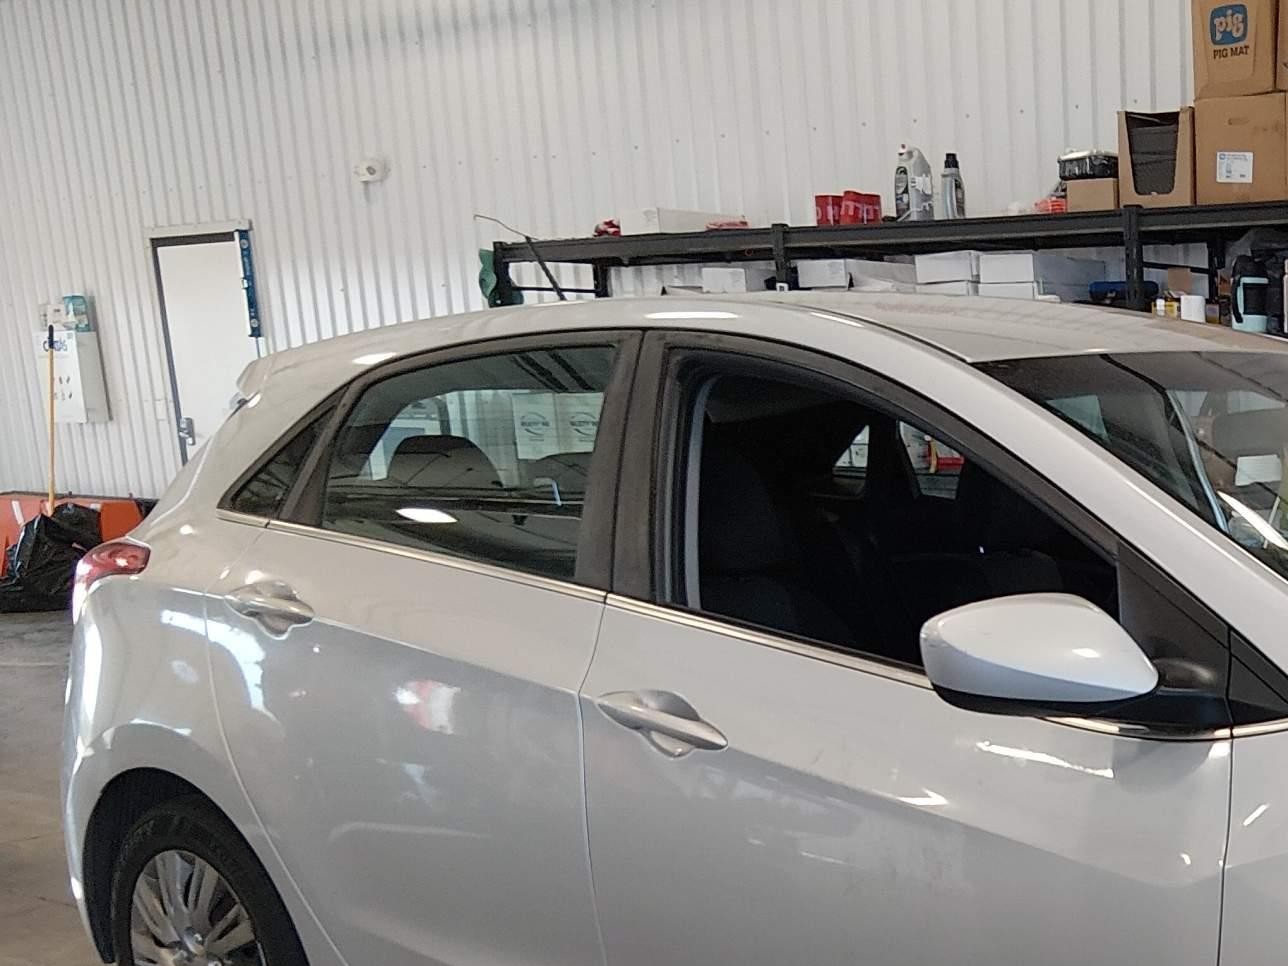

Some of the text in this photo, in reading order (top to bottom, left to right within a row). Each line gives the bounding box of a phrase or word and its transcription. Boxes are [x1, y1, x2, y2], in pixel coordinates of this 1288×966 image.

[1213, 9, 1244, 41] pig
[1213, 45, 1250, 60] PIG MAT
